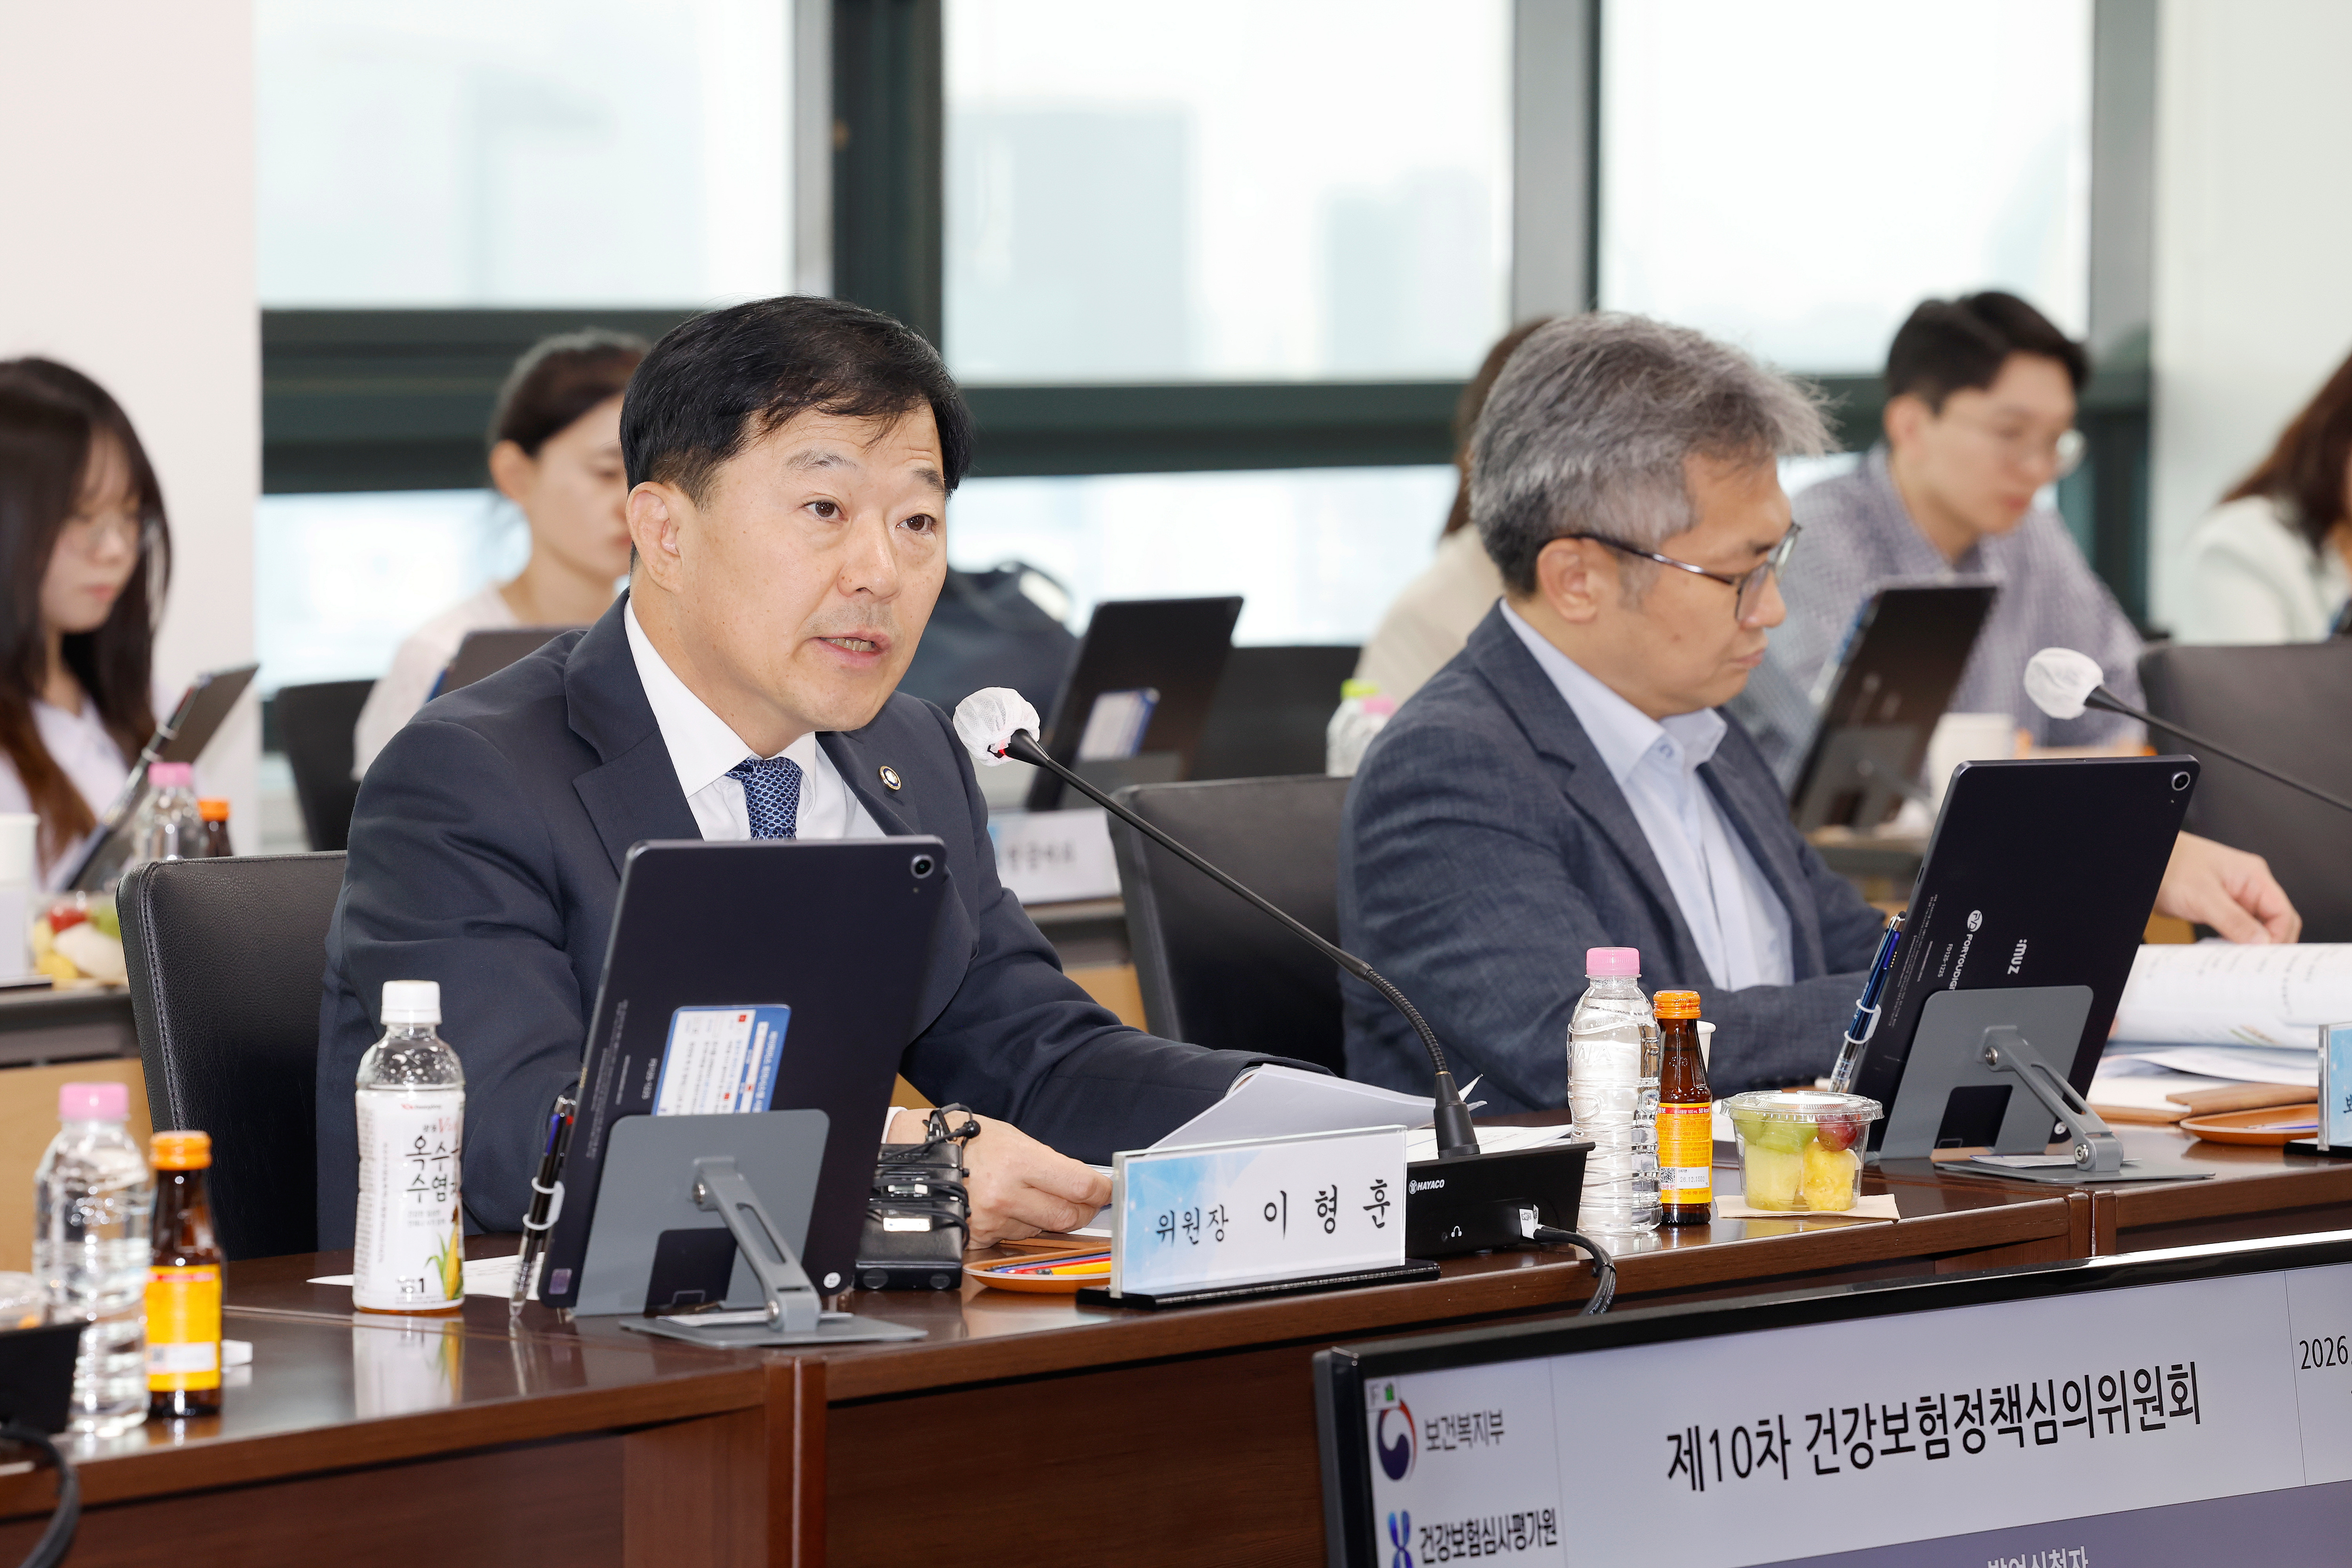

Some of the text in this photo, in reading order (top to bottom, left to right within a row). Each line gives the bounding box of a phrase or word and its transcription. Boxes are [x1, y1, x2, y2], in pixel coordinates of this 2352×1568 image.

[1948, 934, 1973, 990] FORYOUDIGI
[405, 1135, 459, 1172] 옥수
[1417, 1179, 1445, 1192] HAYACO
[1156, 1204, 1229, 1246] 위원장
[1424, 1409, 1504, 1451] 보건복지부
[1667, 1361, 2201, 1492] 제10차 건강보험정책심의위원회
[1419, 1508, 1558, 1565] 건강보험심사평가원
